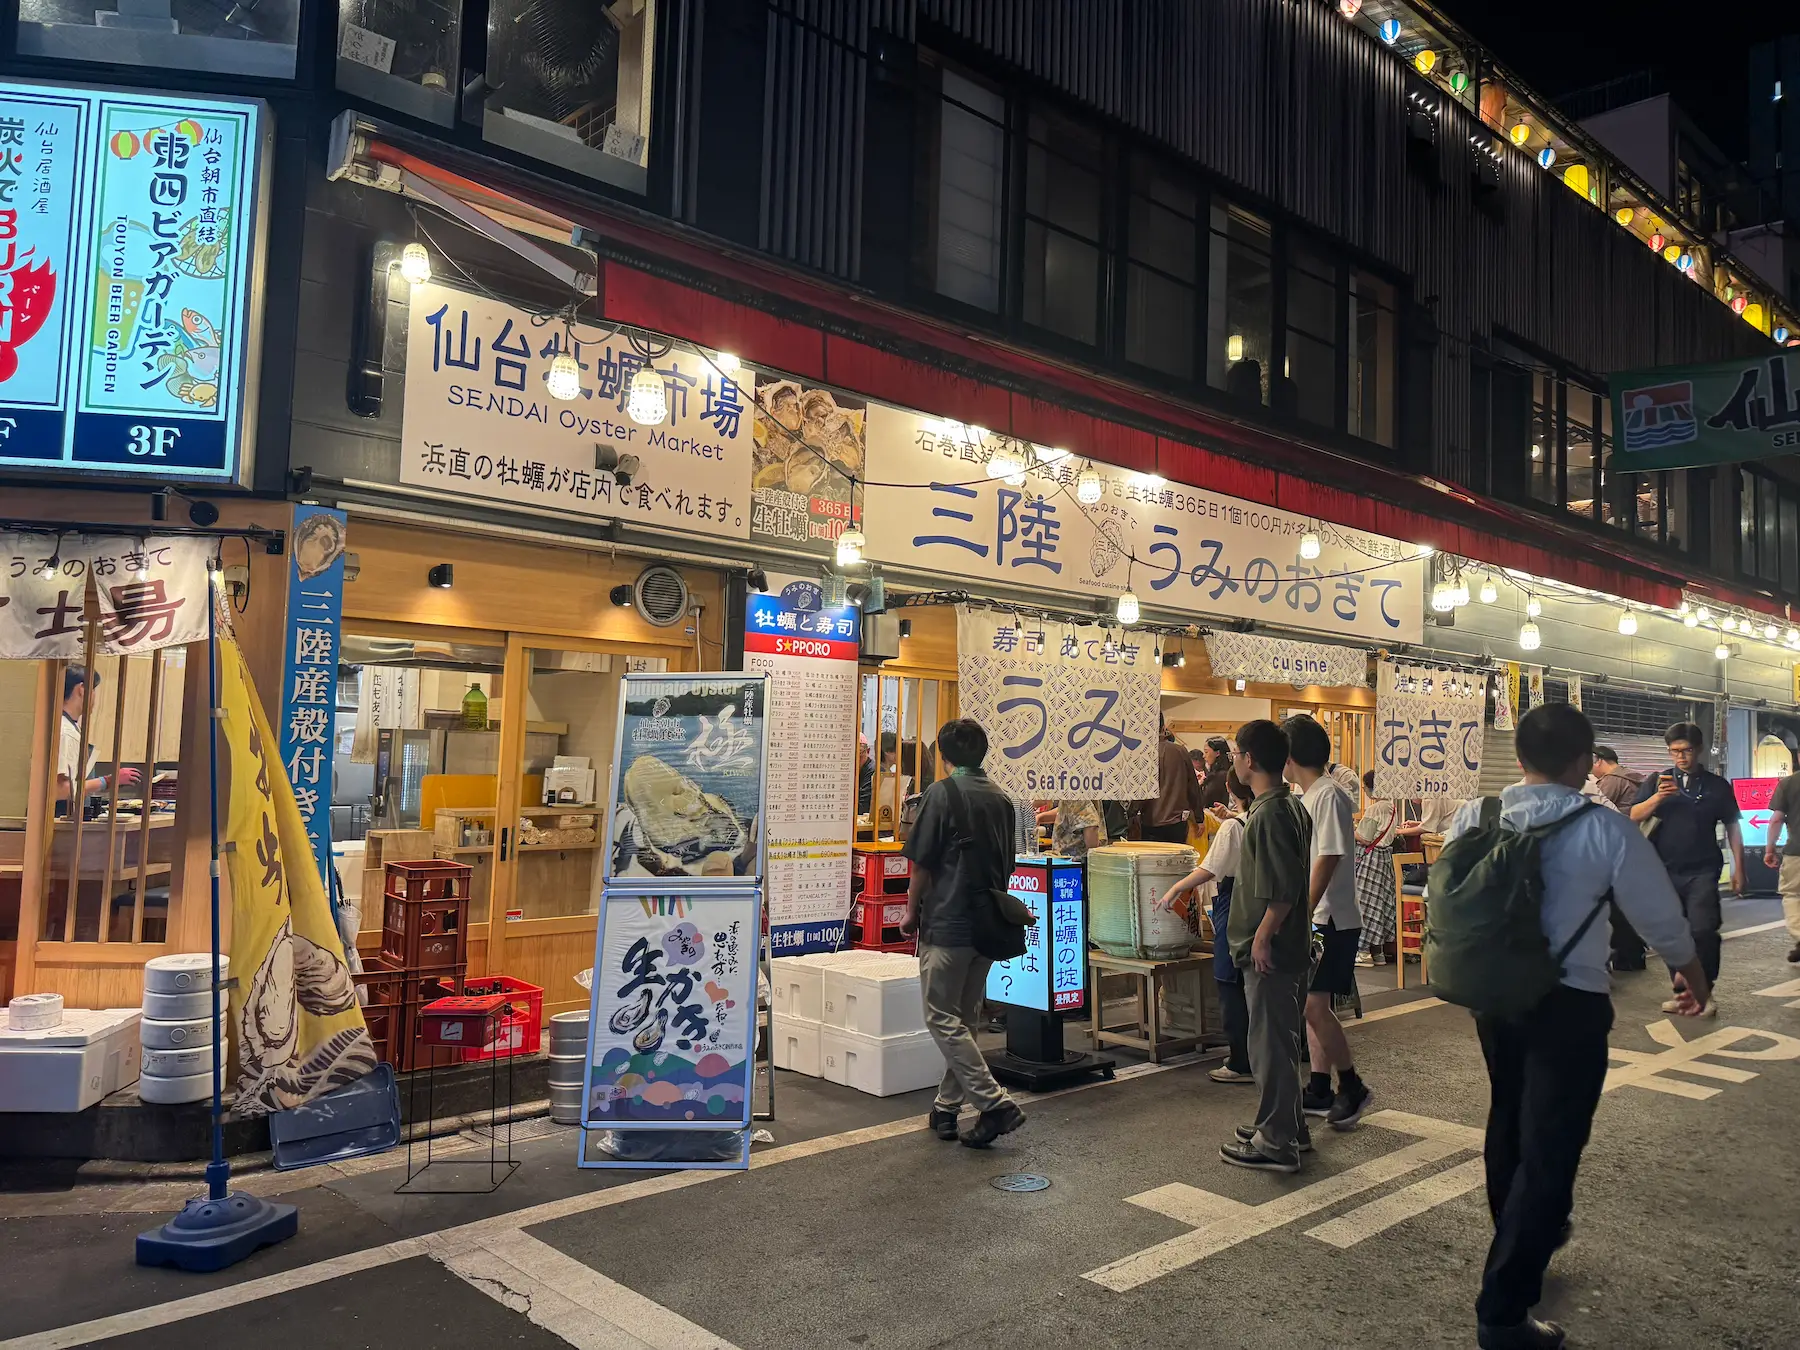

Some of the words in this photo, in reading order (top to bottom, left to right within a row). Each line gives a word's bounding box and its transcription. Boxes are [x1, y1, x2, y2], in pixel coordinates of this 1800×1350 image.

[31, 120, 59, 216] 仙台居酒屋
[197, 127, 224, 244] 仙台朝市直結
[110, 214, 129, 278] TOUYON
[139, 131, 191, 391] 東四ビアガーデン
[19, 284, 41, 323] バーン
[108, 284, 124, 324] BEER
[103, 328, 120, 394] GARDEN
[127, 424, 182, 457] 3F
[447, 384, 549, 425] SENDAI
[559, 409, 638, 443] Oyster
[647, 428, 725, 462] Market
[1773, 431, 1800, 448] SE
[752, 504, 809, 543] 生牡蠣
[913, 481, 1063, 576] 三陸
[785, 582, 824, 600] うみのおき
[1079, 577, 1101, 588] Seafood
[1101, 581, 1121, 590] cuisine
[1145, 523, 1404, 629] うみのおきて
[754, 608, 854, 637] 牡蠣と寿司
[751, 658, 774, 668] FOOD
[992, 626, 1046, 656] 寿司
[1059, 634, 1141, 667] あて巻き
[1272, 656, 1328, 673] cuisine
[627, 680, 689, 697] Ultimate
[690, 680, 742, 698] Oyster
[996, 675, 1142, 764] うみ
[1381, 707, 1479, 771] おきて
[1026, 769, 1104, 791] Seafood
[1416, 777, 1449, 796] shop
[772, 929, 805, 949] 生牡蠣
[1055, 904, 1078, 989] 牡蠣の掟
[616, 936, 710, 1051] 生かき
[1054, 992, 1080, 1006] 昼限定
